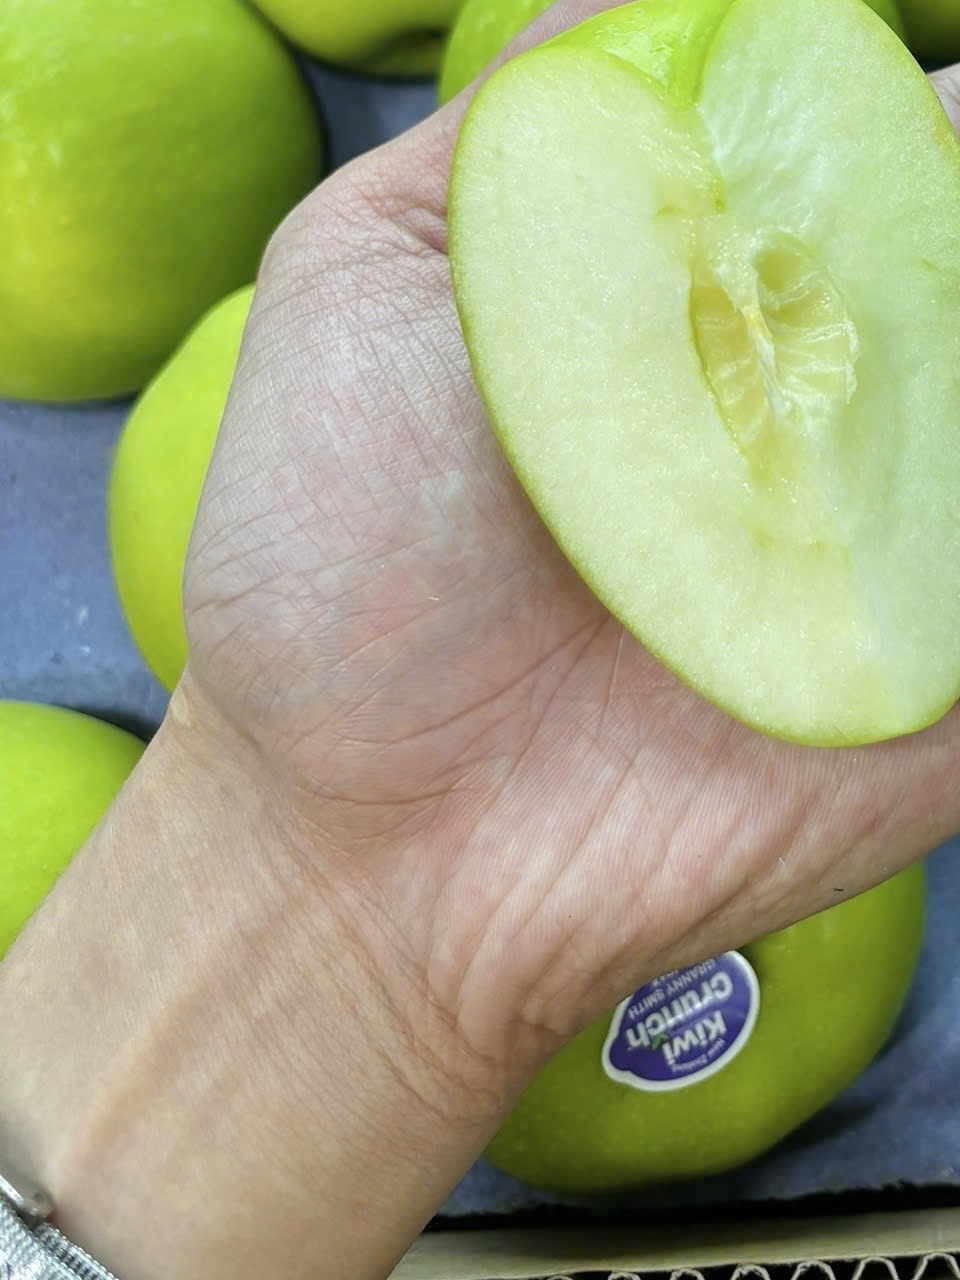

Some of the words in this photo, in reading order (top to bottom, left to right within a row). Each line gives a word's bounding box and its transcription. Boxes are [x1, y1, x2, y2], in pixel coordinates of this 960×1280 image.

[667, 959, 717, 997] GRANNY
[626, 972, 734, 1048] Crunch
[628, 989, 666, 1020] SMITH
[661, 1010, 728, 1066] Kiwi
